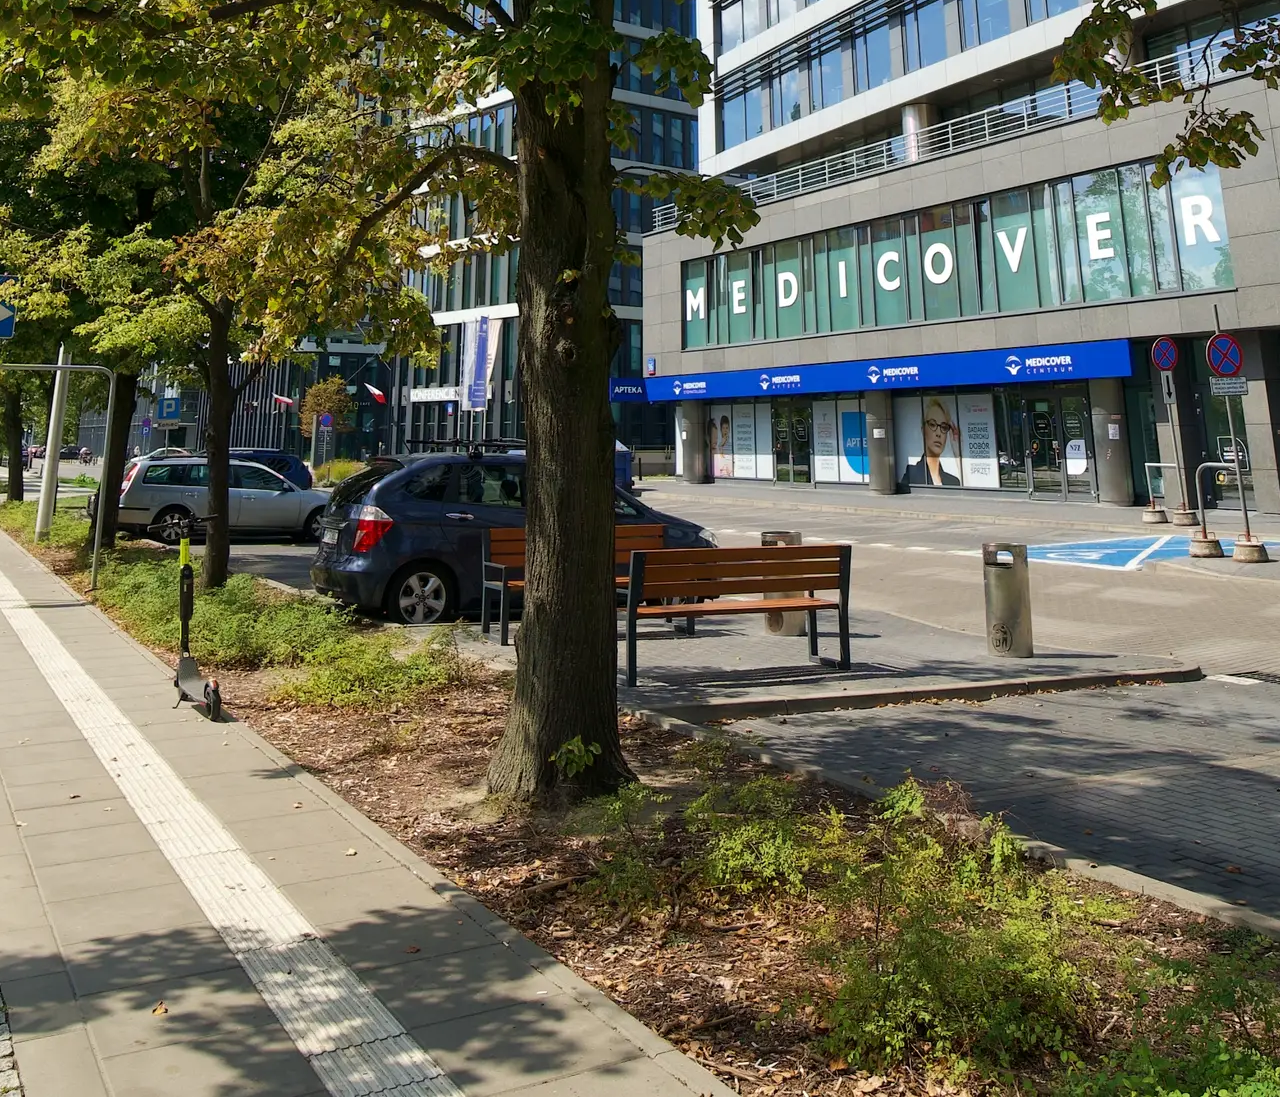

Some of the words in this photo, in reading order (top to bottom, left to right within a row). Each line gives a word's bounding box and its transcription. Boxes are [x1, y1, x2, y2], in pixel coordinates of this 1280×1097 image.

[685, 195, 1221, 321] MEDICOVER
[1025, 355, 1072, 367] MEDICOVER
[883, 367, 919, 377] MEDICOVER
[1026, 366, 1074, 374] CENTRUM
[772, 375, 800, 383] MEDICOVER
[683, 381, 706, 389] MEDICOVER
[614, 386, 643, 394] APTEKA
[163, 399, 176, 417] P
[969, 441, 990, 450] DOBÓR
